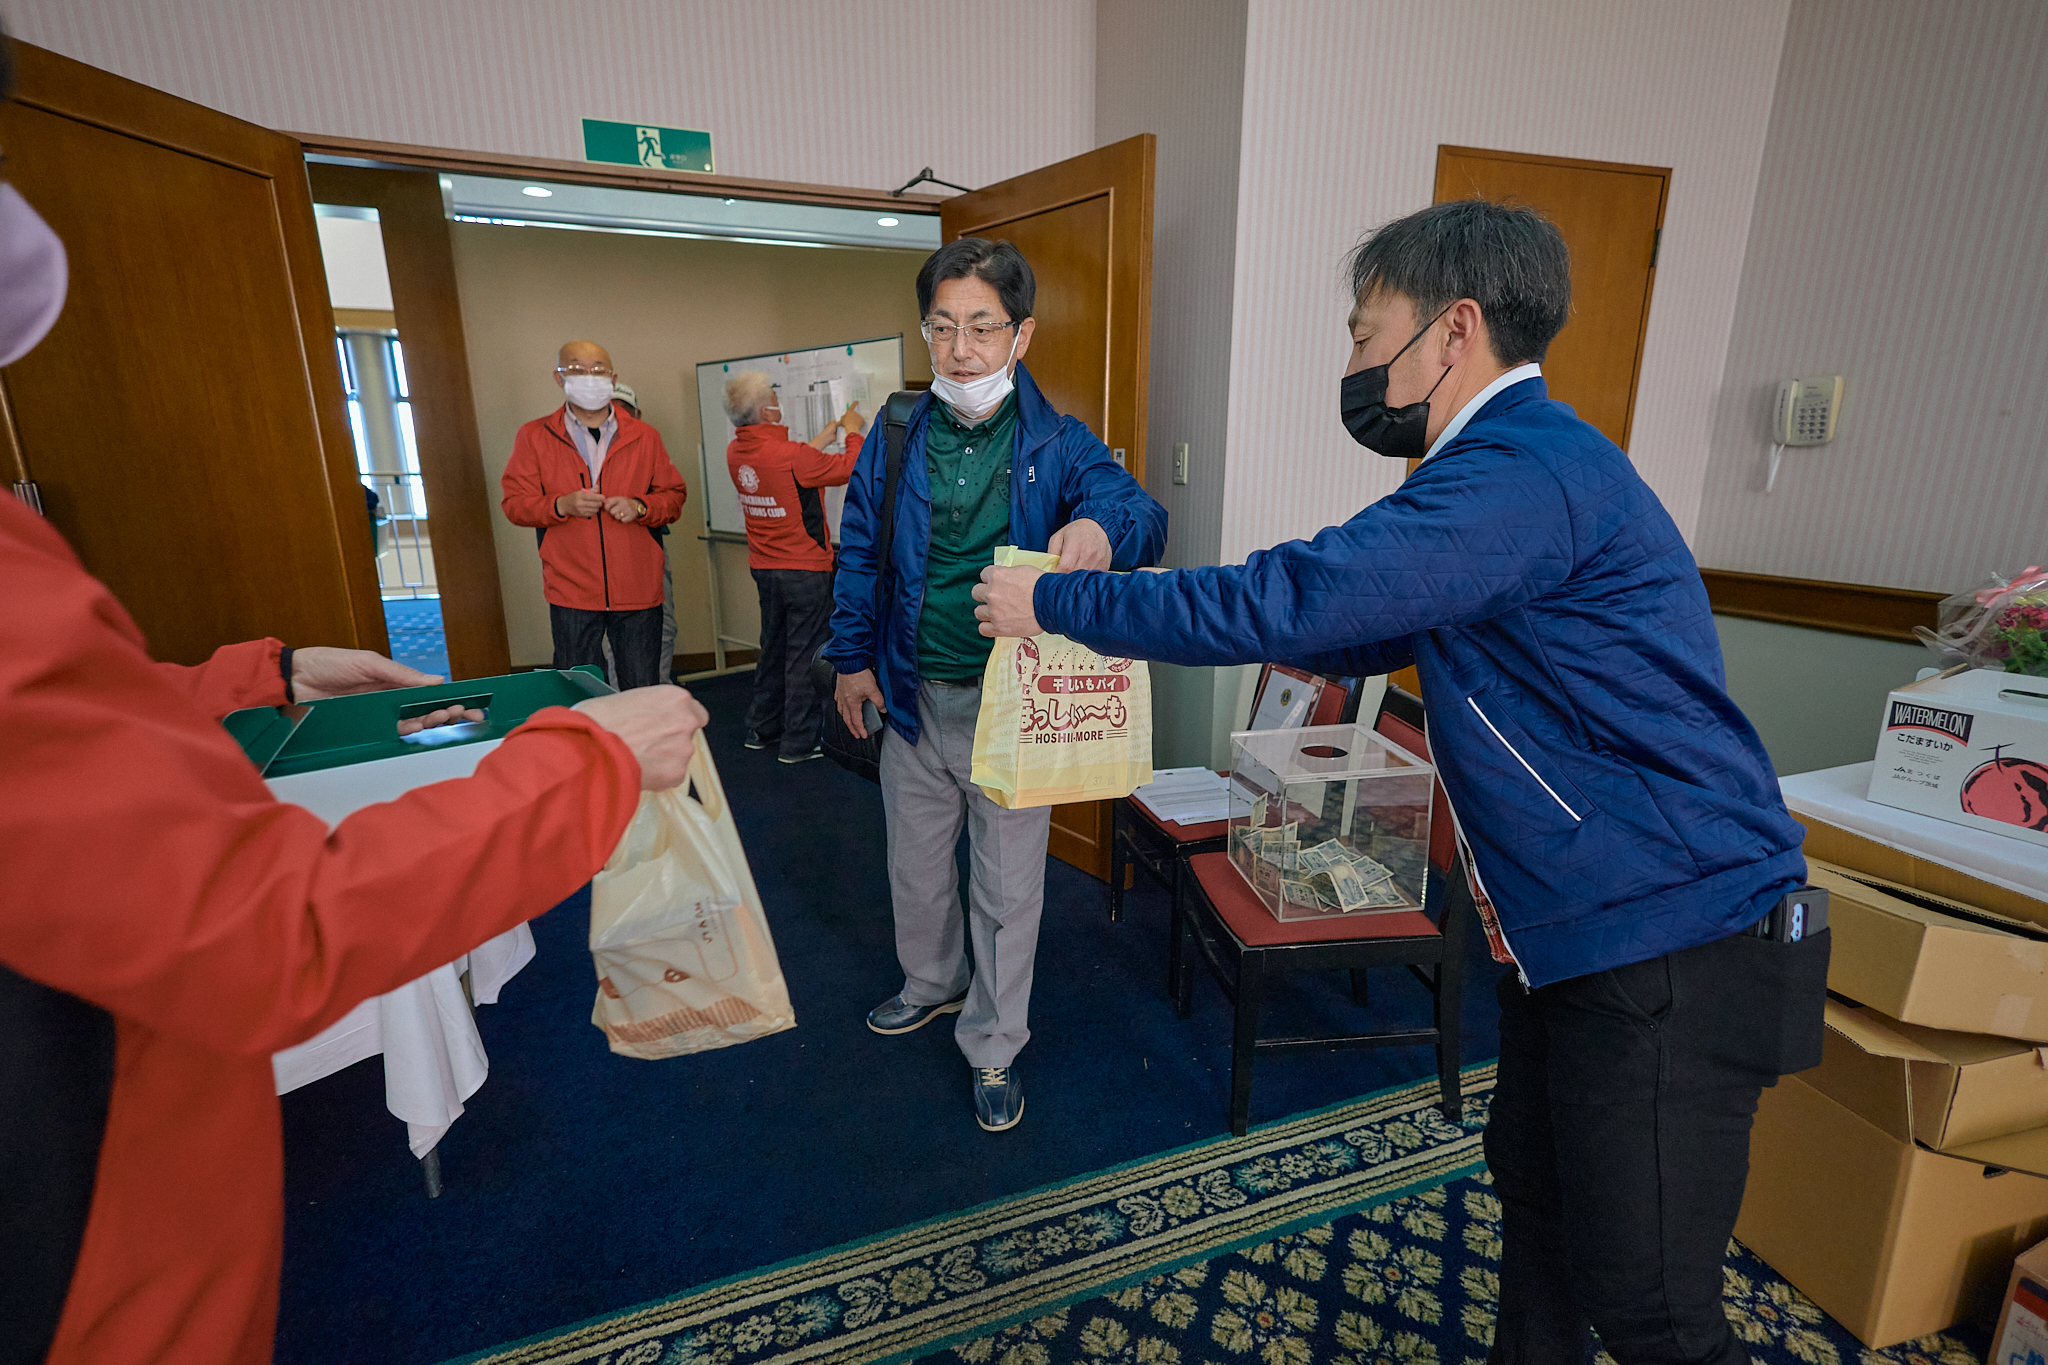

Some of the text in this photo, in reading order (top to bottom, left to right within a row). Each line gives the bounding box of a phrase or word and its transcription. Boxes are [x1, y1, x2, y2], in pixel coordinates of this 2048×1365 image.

[767, 507, 787, 518] CLUB
[1894, 703, 1967, 738] WATERMELON
[1897, 732, 1953, 752] こだますいか
